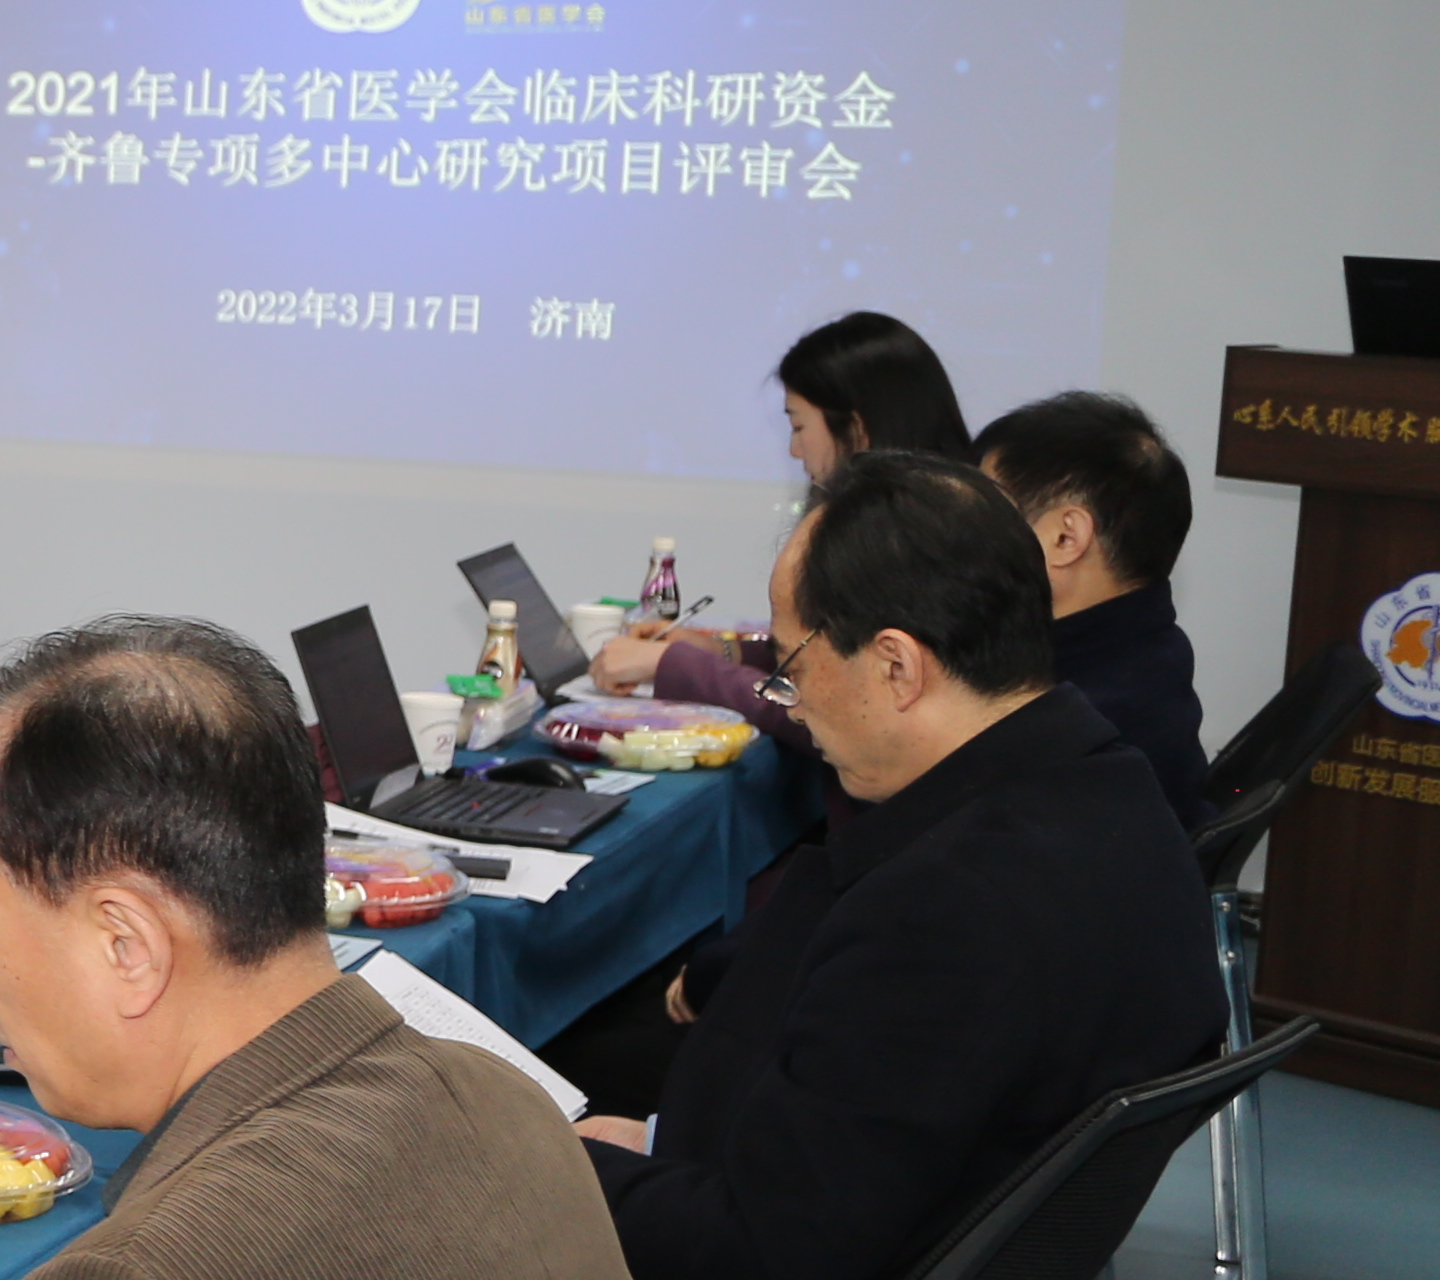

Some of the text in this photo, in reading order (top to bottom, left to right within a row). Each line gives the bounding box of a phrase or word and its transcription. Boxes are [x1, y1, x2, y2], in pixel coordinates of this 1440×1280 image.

[464, 1, 606, 26] 山东省医学会
[5, 67, 897, 133] 2021年山东省医学会临床科研资金
[26, 132, 864, 202] -齐鲁专项多中心研究项目评审会
[216, 286, 616, 342] 2022年3月17日 济南
